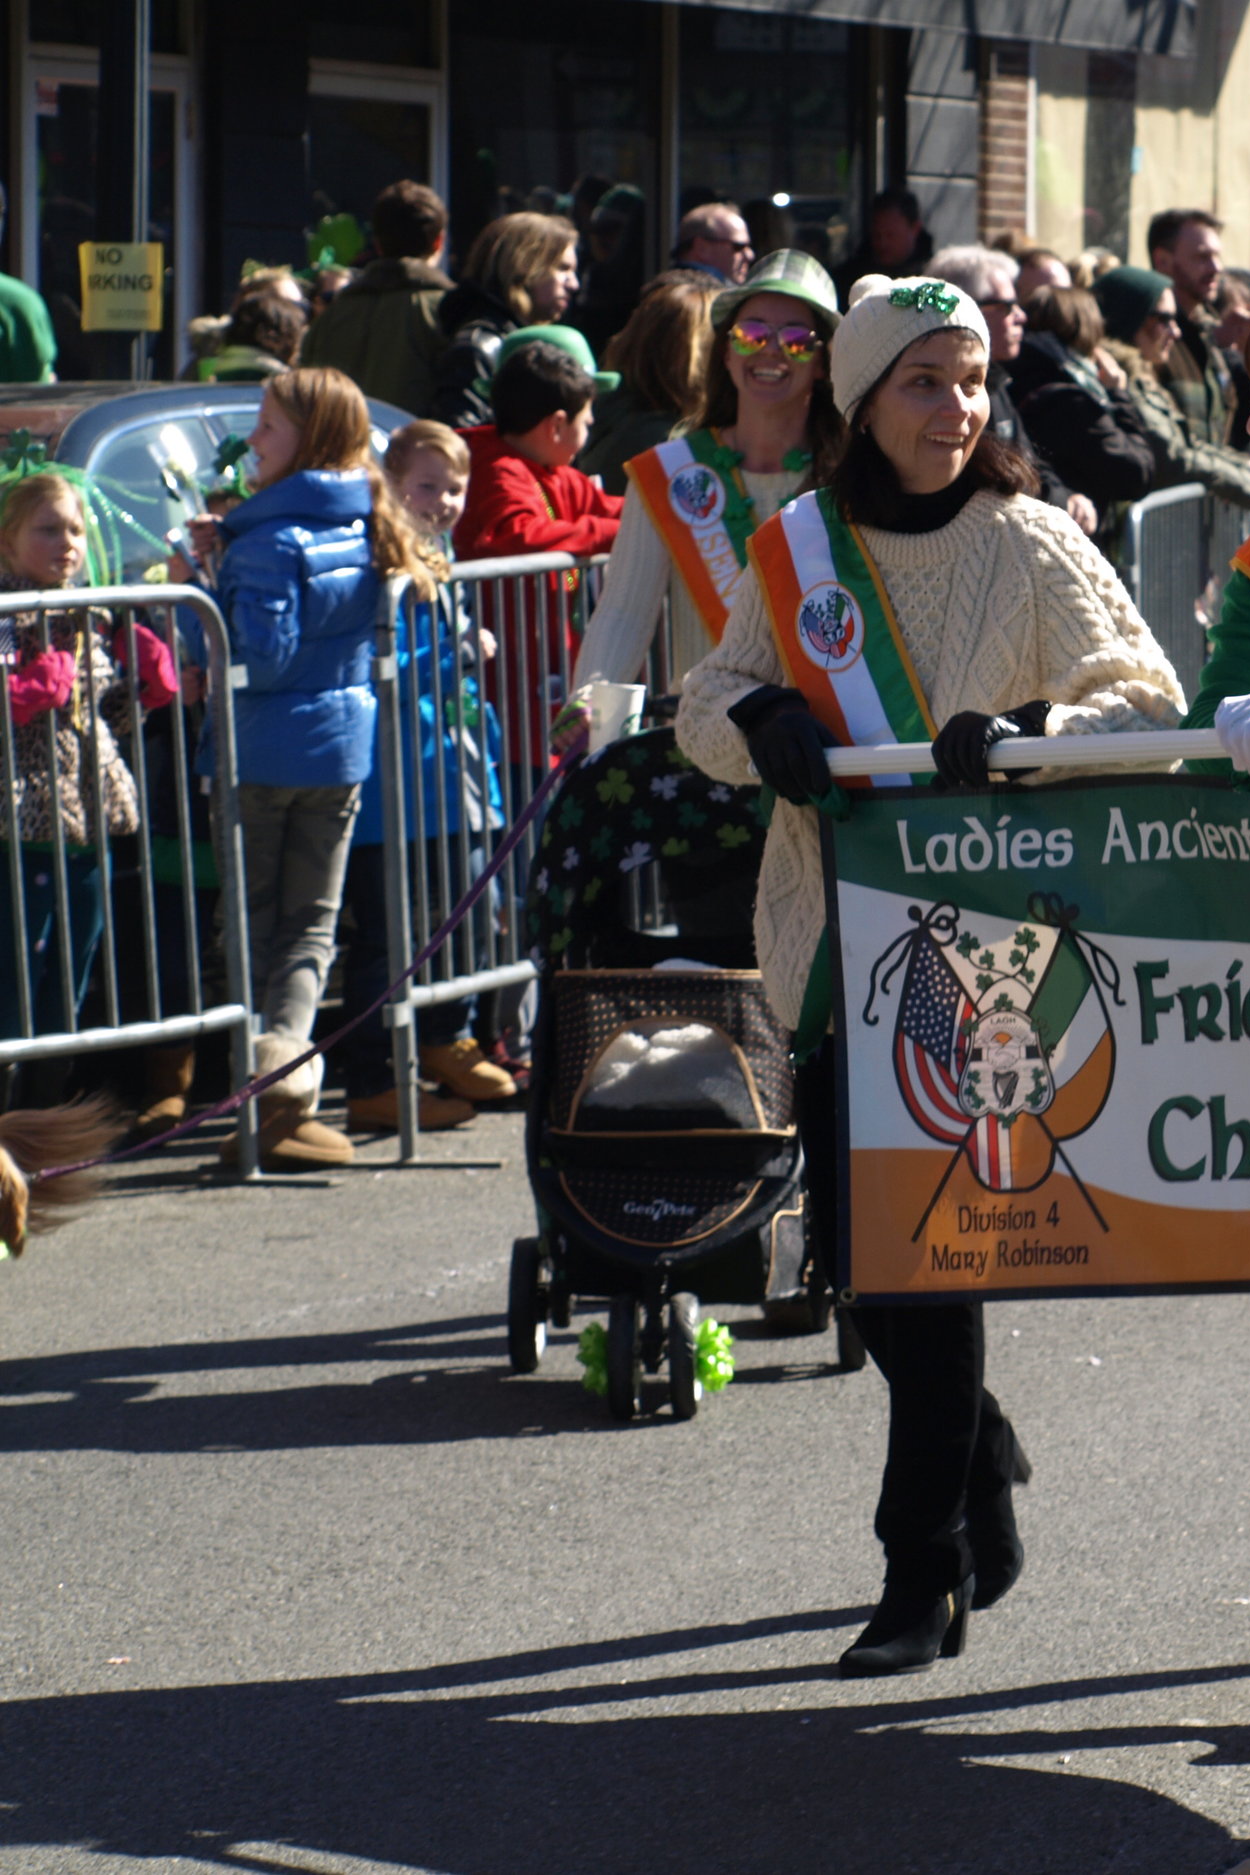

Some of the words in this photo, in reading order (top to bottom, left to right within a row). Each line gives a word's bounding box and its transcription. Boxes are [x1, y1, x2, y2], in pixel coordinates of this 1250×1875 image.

[95, 247, 122, 266] NO
[897, 814, 1074, 874] Ladies
[958, 1204, 1036, 1234] Division
[1046, 1201, 1060, 1227] 4
[931, 1244, 989, 1277] Mary
[997, 1239, 1089, 1269] Robinson
